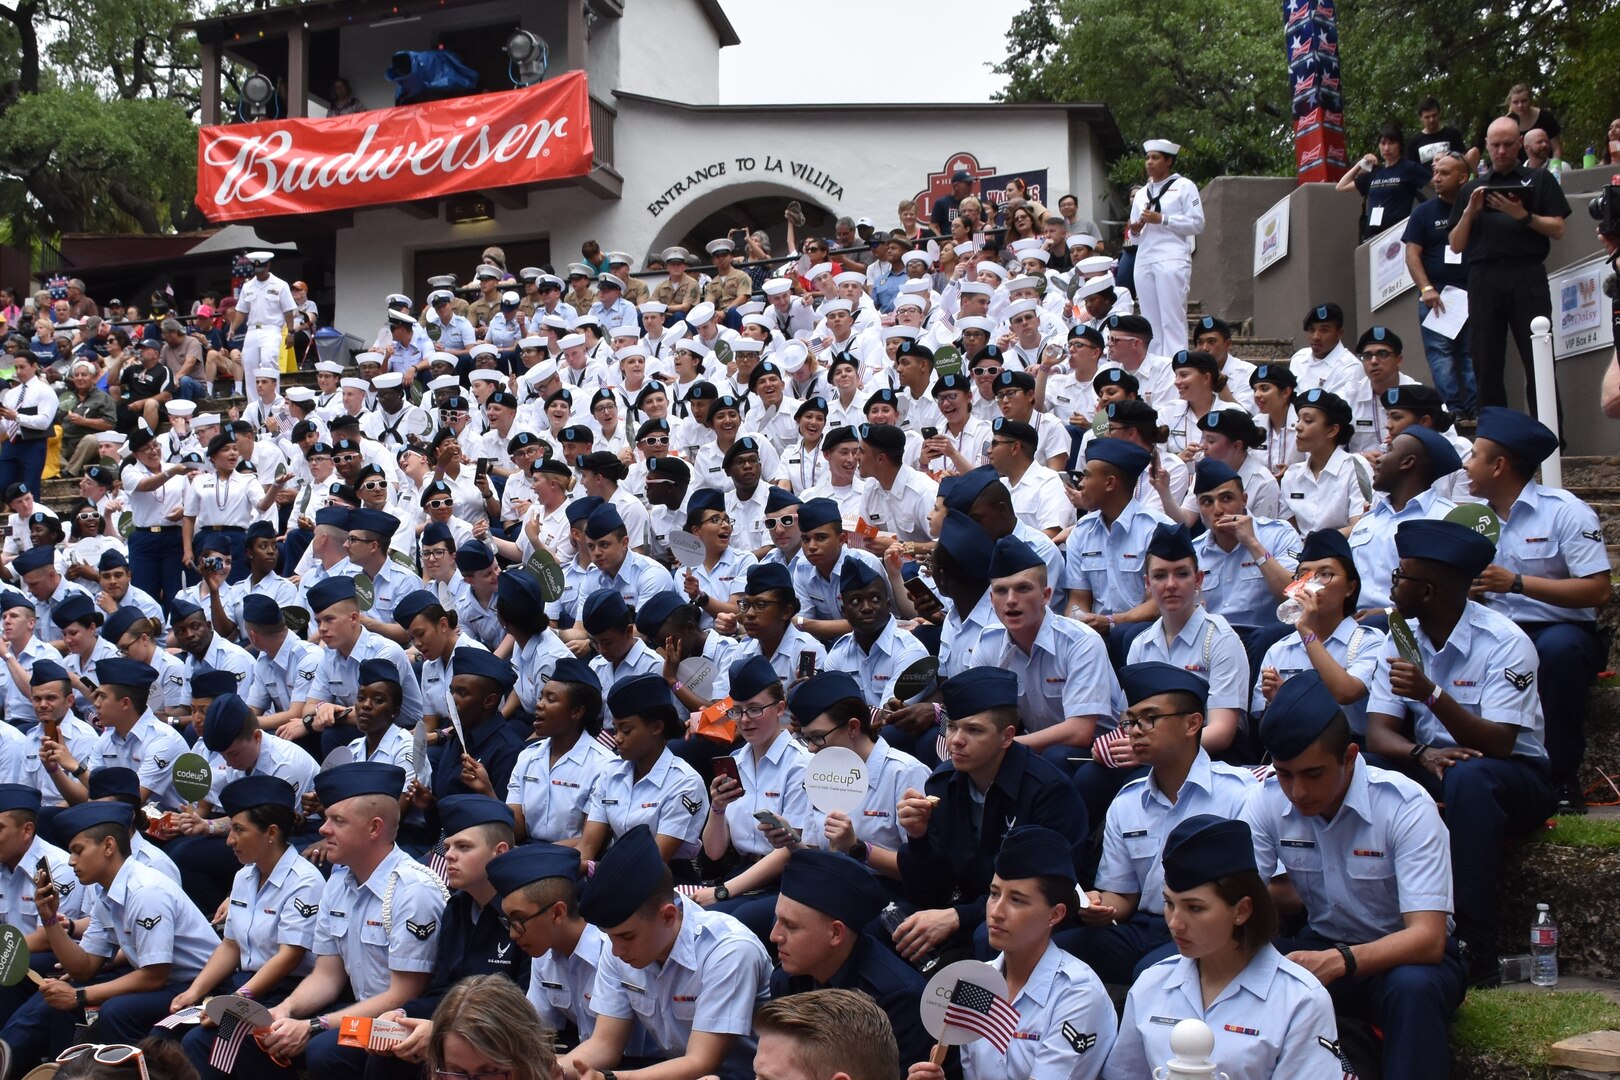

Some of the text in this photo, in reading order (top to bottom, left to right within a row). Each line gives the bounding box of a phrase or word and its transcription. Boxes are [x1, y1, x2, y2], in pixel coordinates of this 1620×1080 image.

[204, 115, 568, 206] Budweiser
[647, 156, 844, 218] ENTRANCE TO LA VILLITA
[1565, 339, 1575, 349] VIP
[1576, 336, 1587, 347] Box
[177, 770, 204, 782] codeup
[812, 771, 855, 787] codeup
